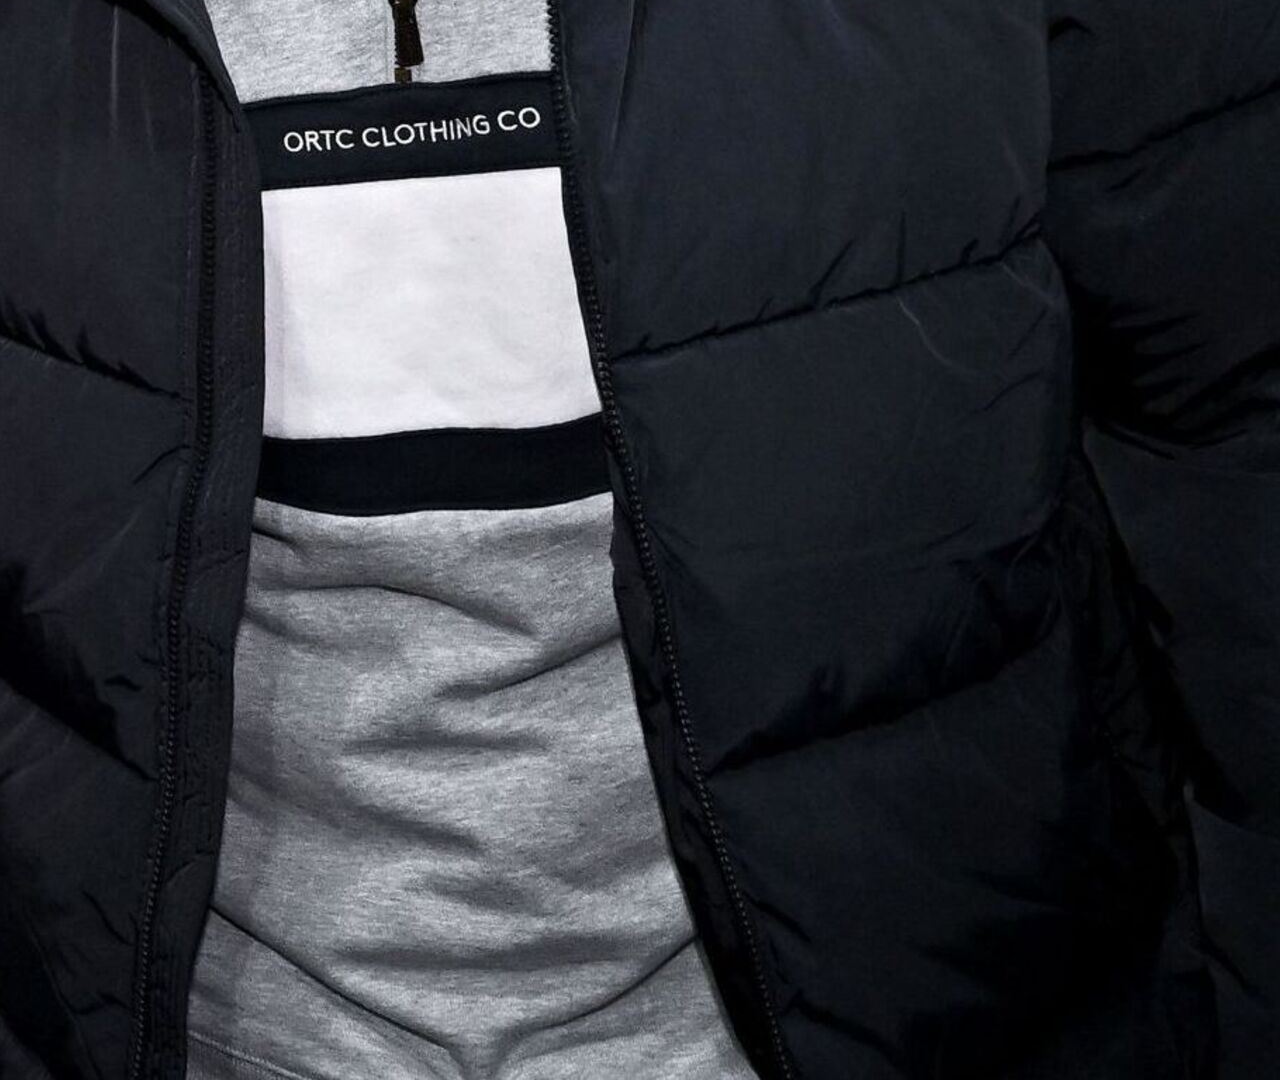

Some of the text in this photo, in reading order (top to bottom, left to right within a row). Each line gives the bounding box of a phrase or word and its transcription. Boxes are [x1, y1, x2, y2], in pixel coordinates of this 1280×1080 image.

[283, 106, 541, 153] ORTC CLOTHING CO
